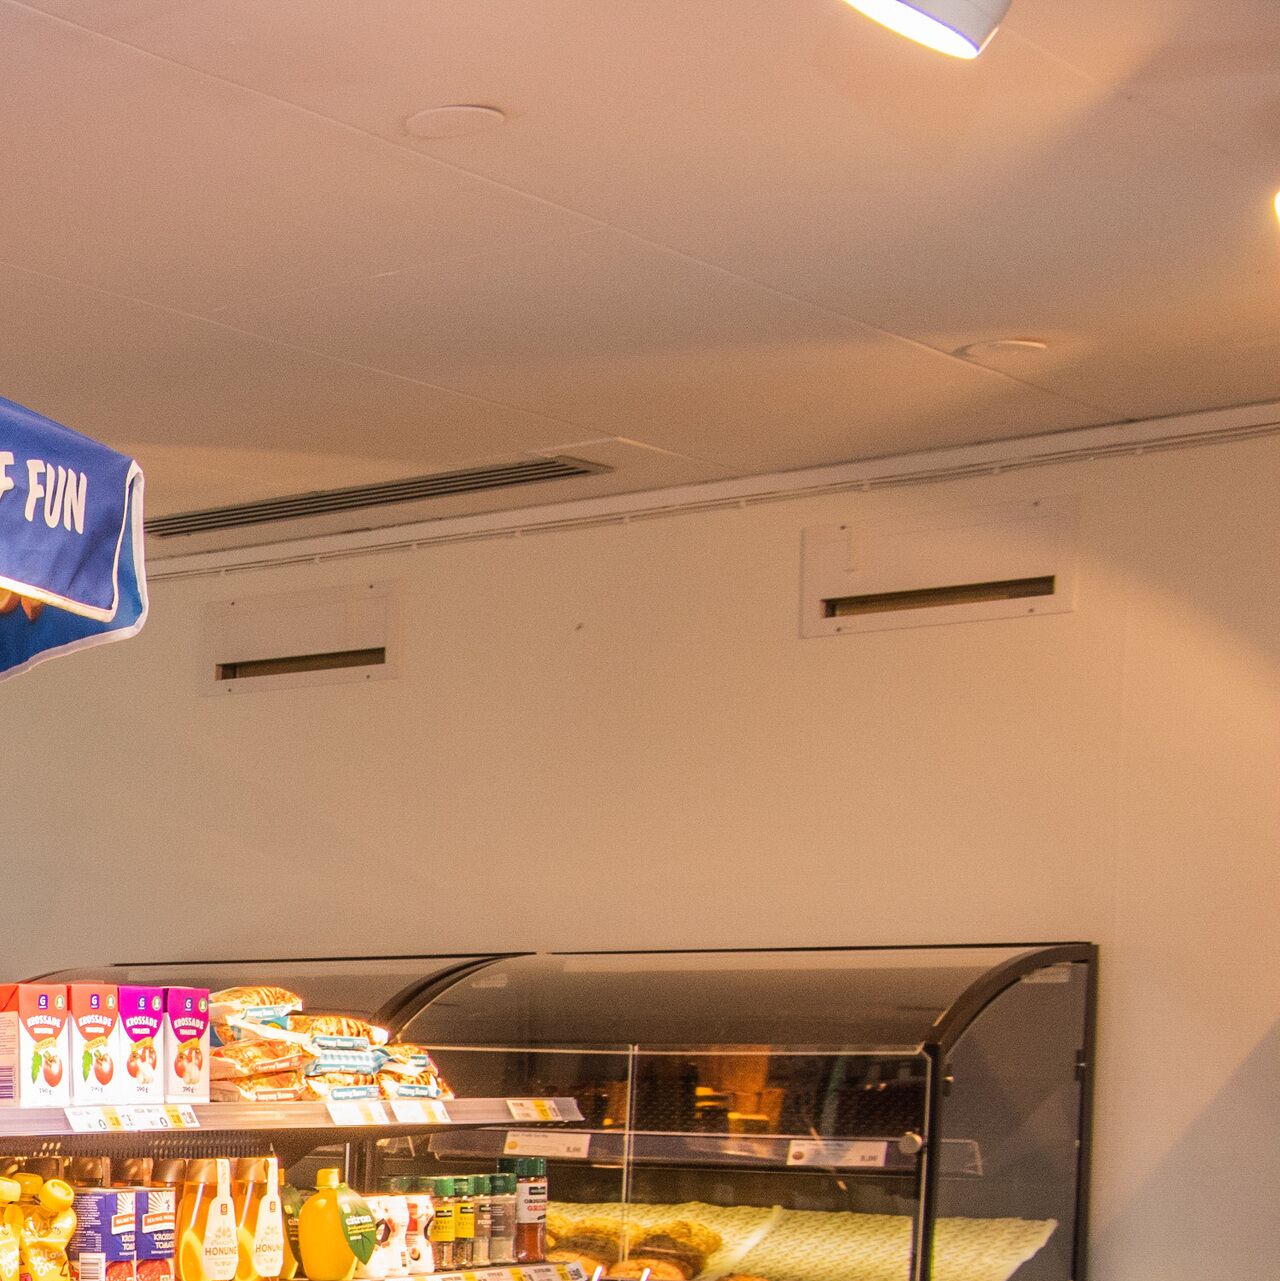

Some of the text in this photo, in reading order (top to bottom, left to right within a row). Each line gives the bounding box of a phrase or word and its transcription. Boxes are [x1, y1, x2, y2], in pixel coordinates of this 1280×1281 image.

[25, 459, 86, 534] FUN
[126, 1018, 158, 1028] KROSSADE
[174, 1018, 205, 1029] KROSSADE
[346, 1214, 372, 1225] citron
